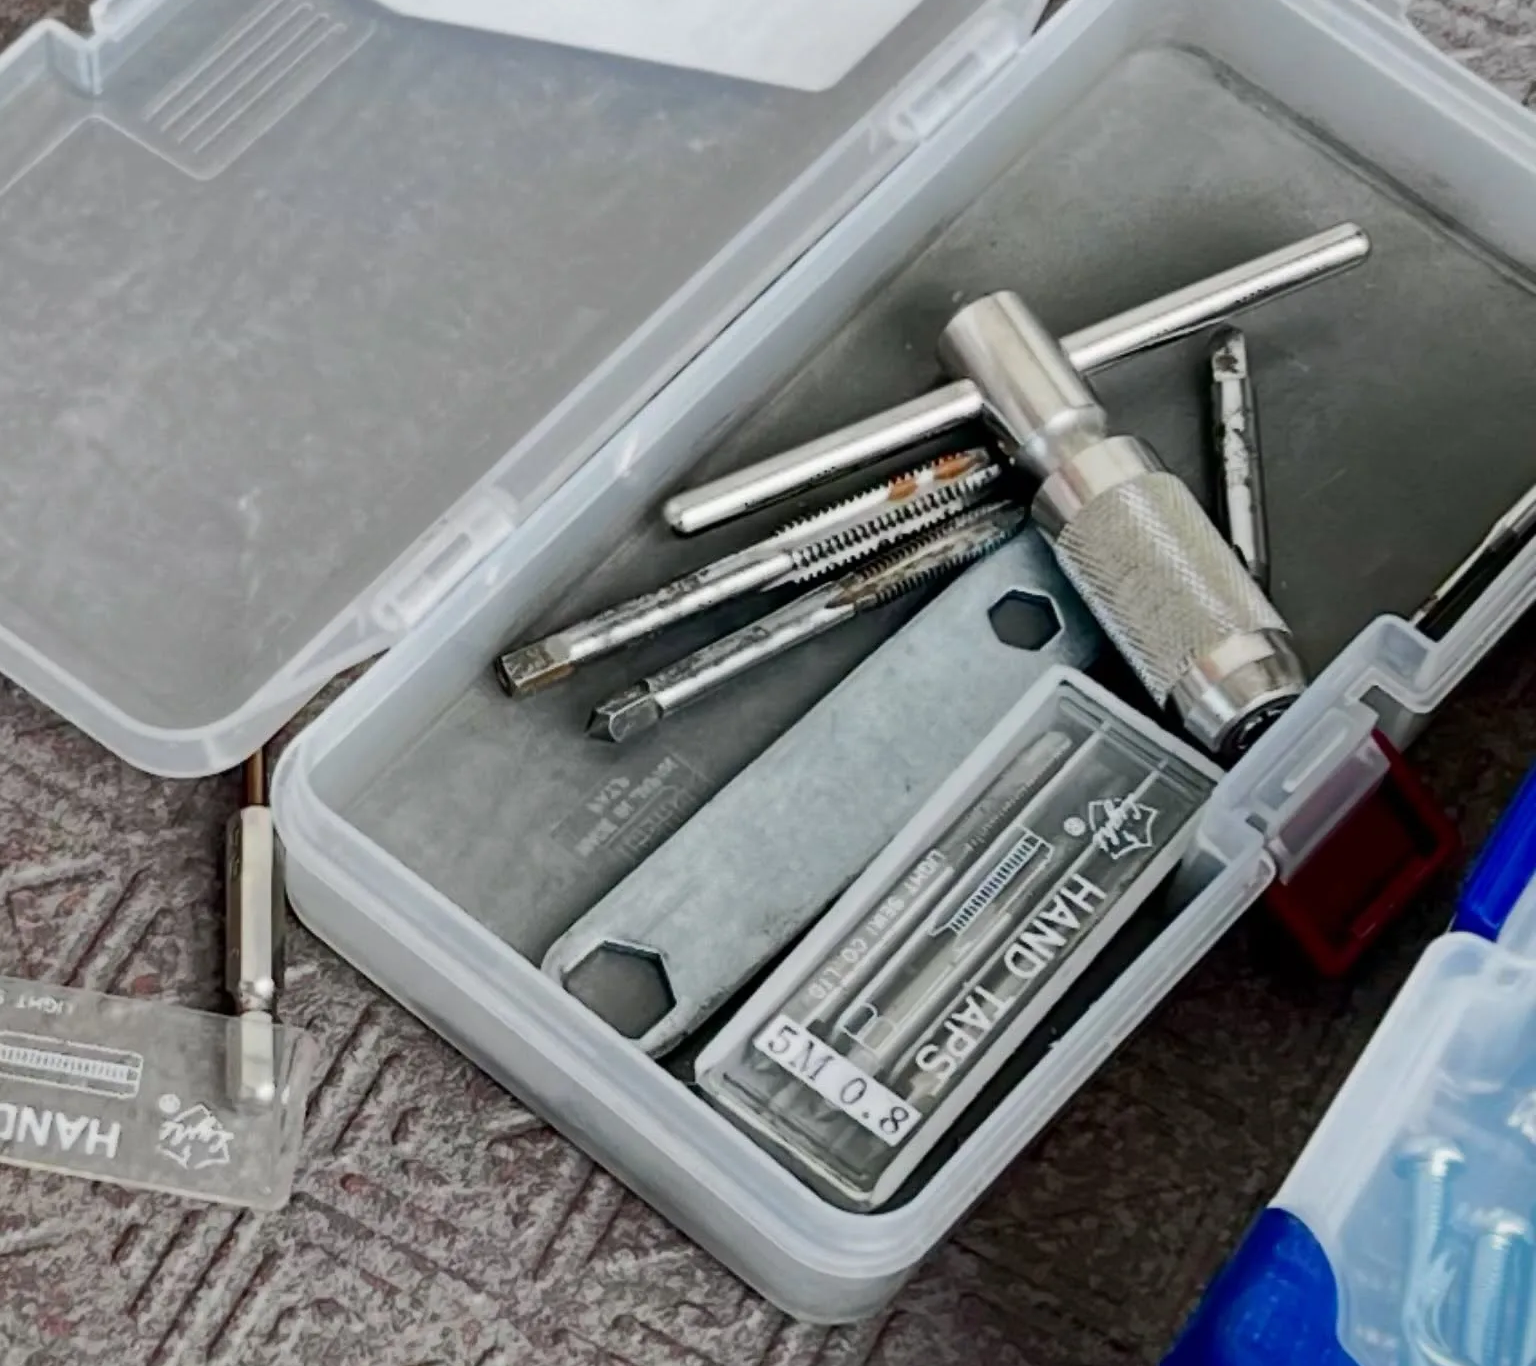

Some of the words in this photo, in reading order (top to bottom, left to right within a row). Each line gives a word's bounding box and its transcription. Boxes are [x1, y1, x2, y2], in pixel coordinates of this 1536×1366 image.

[903, 848, 947, 894] LIGHT
[840, 938, 868, 963] CO
[1004, 873, 1107, 979] HAND
[16, 994, 75, 1016] LIGHT
[916, 986, 1015, 1082] TAPS
[768, 1024, 834, 1081] 5M
[840, 1078, 909, 1134] 0.8
